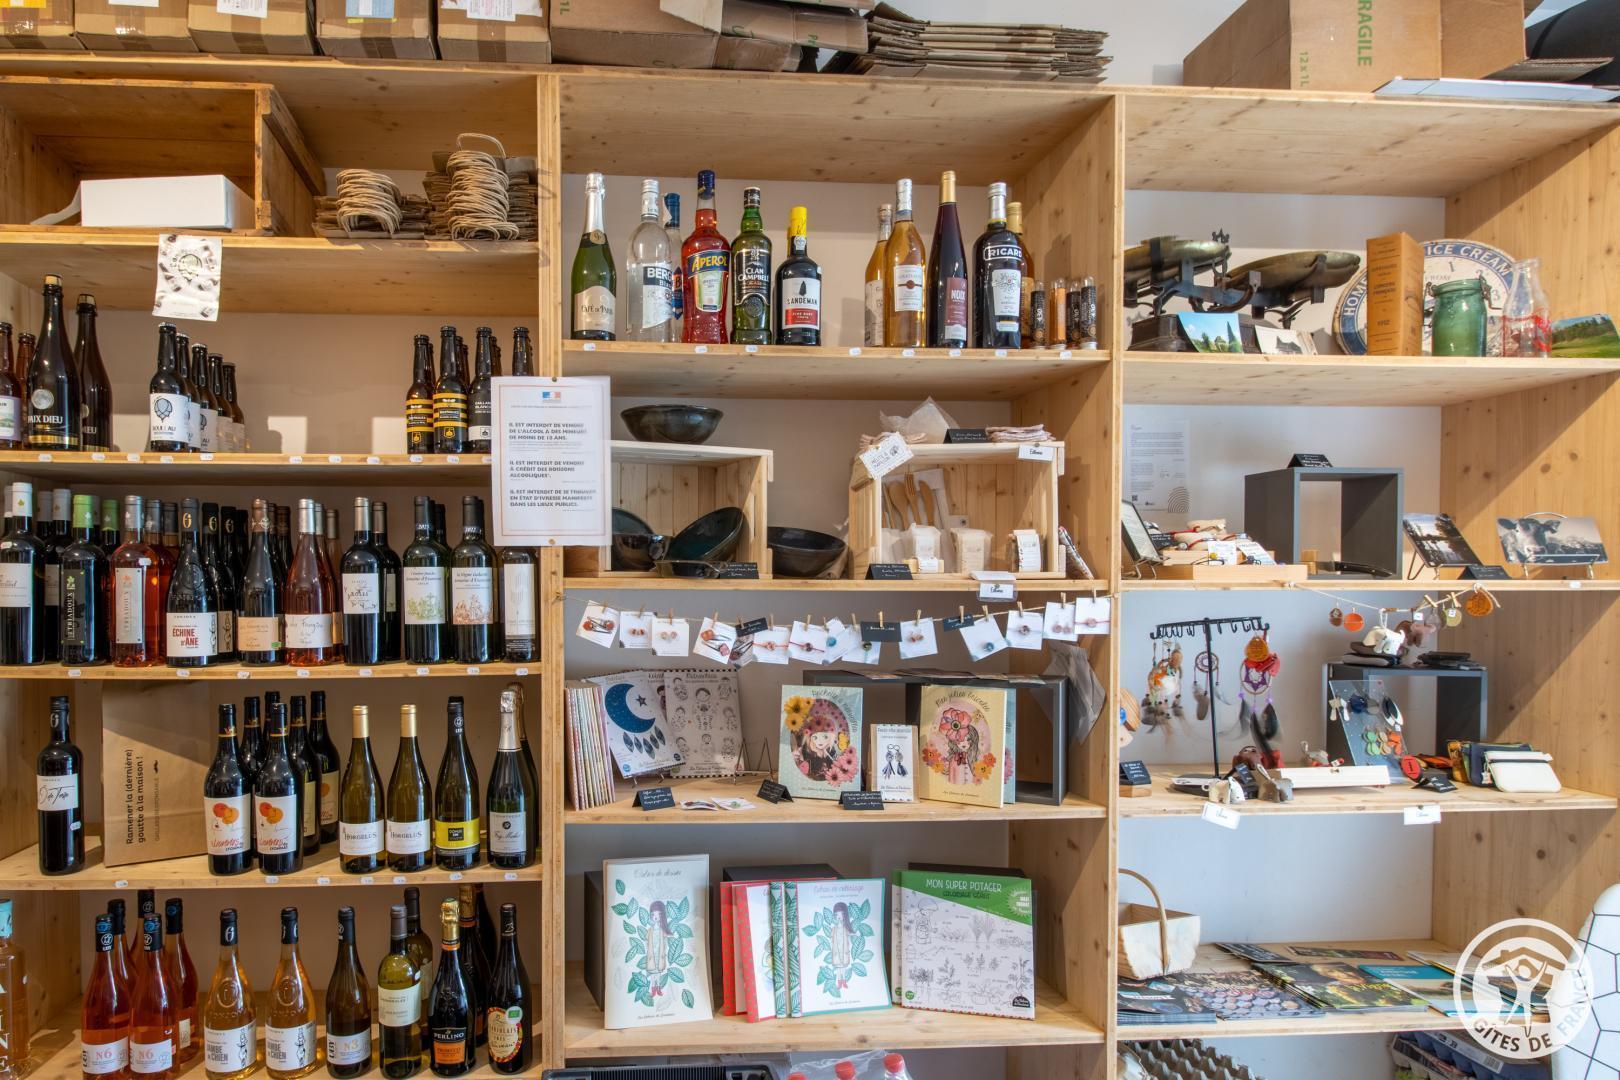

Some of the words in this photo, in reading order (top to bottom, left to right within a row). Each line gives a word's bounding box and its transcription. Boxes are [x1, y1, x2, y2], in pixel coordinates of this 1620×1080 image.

[1358, 0, 1372, 66] RAGILE
[989, 248, 1021, 259] RICARD
[692, 255, 727, 272] APEROL
[1427, 244, 1453, 256] ICE
[1459, 246, 1512, 278] CREAM
[647, 267, 673, 281] BERG
[746, 267, 764, 276] CLAN
[738, 273, 769, 283] CAMPBELL
[787, 296, 818, 306] SANDEMAN
[43, 415, 63, 424] DIEU
[126, 749, 134, 791] (dernière)
[126, 792, 133, 801] la
[138, 794, 144, 802] la
[926, 879, 943, 888] MON
[945, 880, 967, 890] SUPER
[970, 881, 1002, 893] POTAGER
[434, 1032, 465, 1040] PERLINO
